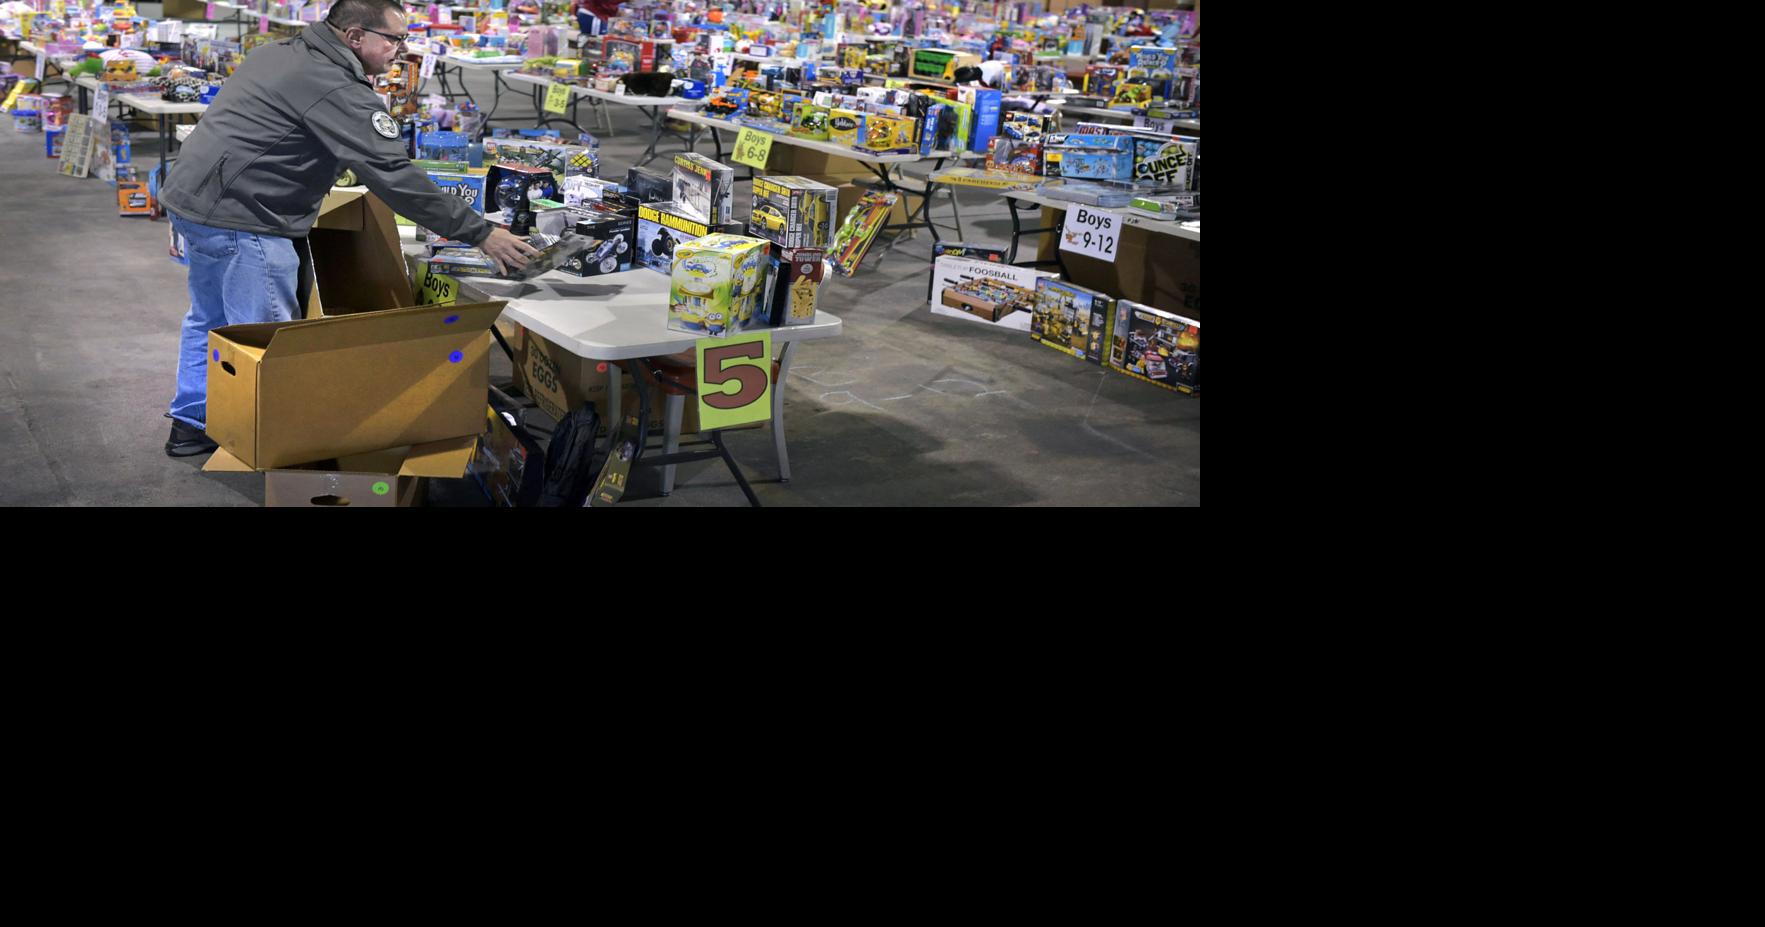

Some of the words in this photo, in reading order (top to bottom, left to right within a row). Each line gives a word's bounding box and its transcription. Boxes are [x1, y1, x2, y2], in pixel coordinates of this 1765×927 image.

[1144, 119, 1164, 131] Boys
[744, 130, 767, 146] Boys
[747, 146, 766, 162] 6-8
[1137, 152, 1186, 174] OUNCE
[639, 205, 659, 223] DODGE
[660, 212, 707, 238] RAMMUNITION
[1076, 208, 1112, 230] Boys
[1083, 231, 1114, 254] 9-12
[969, 266, 1018, 281] FOOSBALL
[424, 272, 450, 298] Boys
[533, 362, 558, 393] EGGS
[701, 340, 768, 410] 5
